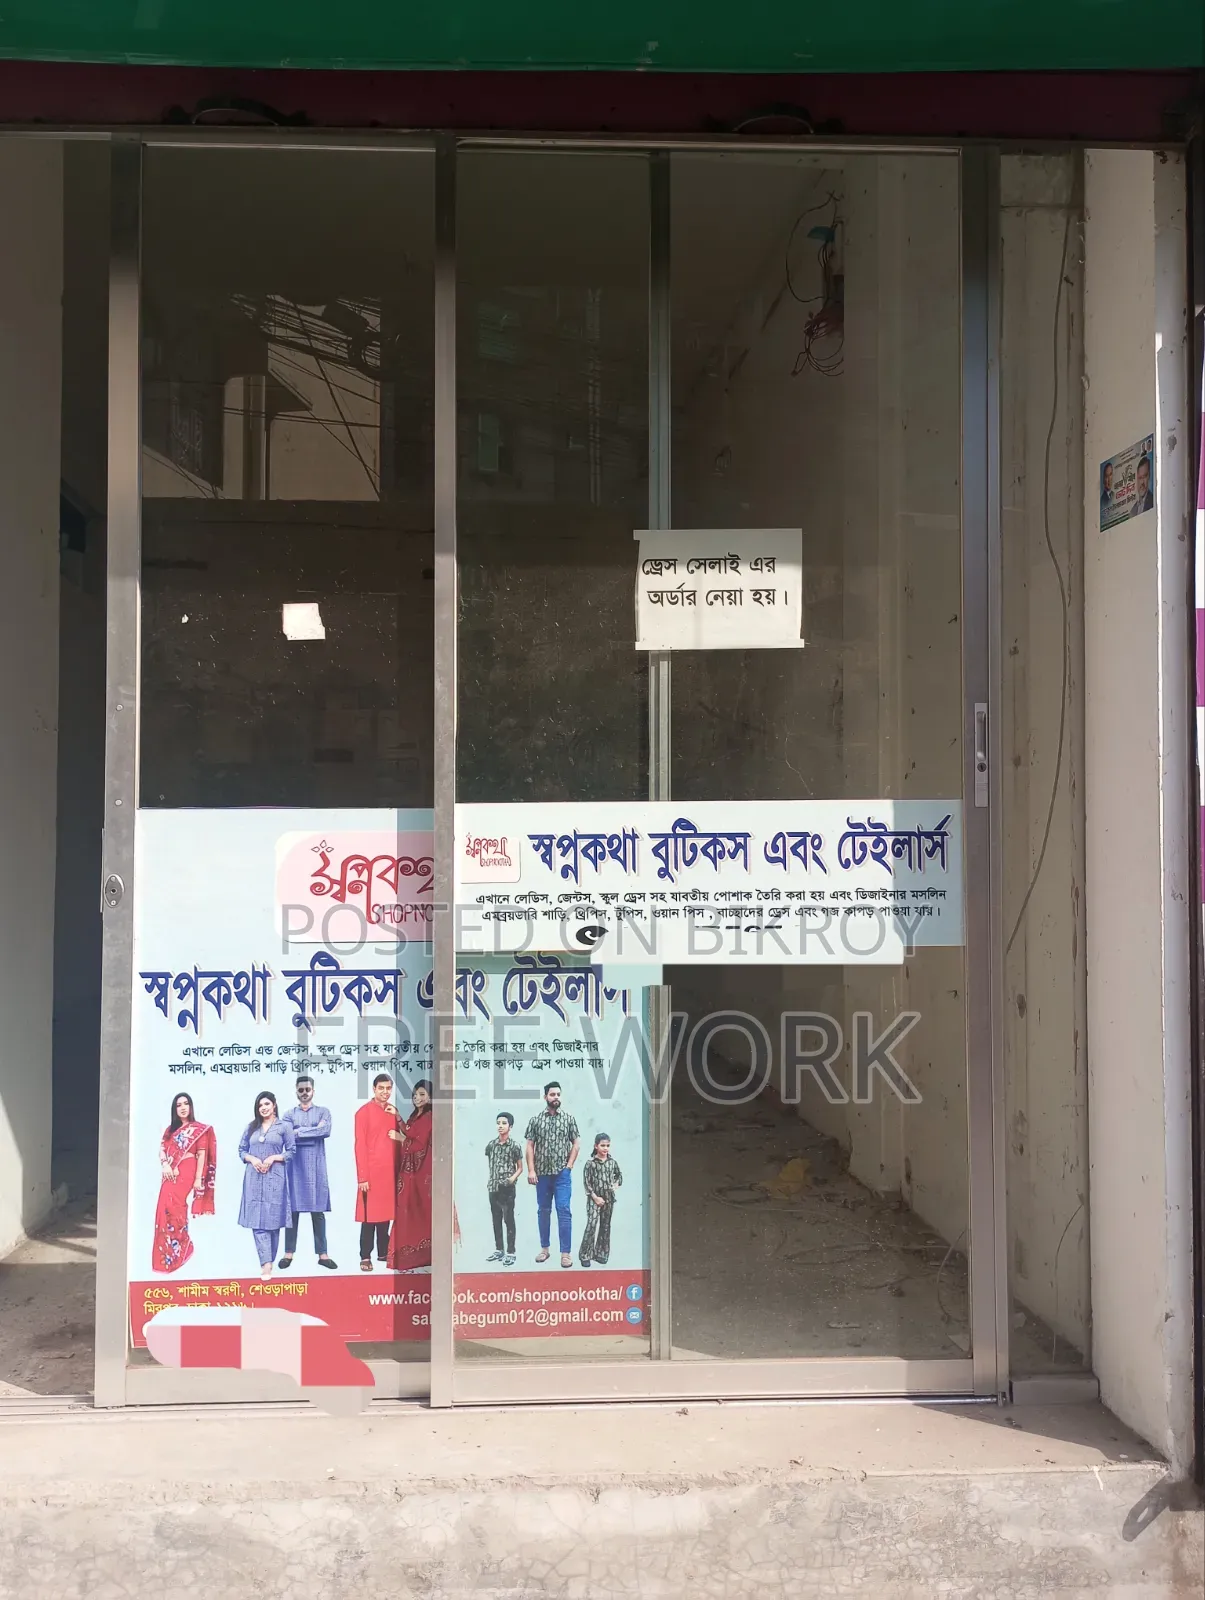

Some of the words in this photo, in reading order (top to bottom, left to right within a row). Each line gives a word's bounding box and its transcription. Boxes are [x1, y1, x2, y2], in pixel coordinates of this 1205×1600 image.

[642, 558, 678, 576] ড্রেস
[686, 552, 741, 575] সেলাই
[750, 557, 776, 574] এর
[647, 582, 697, 607] অর্ডার
[705, 587, 743, 606] নেয়া
[528, 827, 640, 885] স্বপ্নকথা
[648, 818, 751, 883] বুটিকস
[764, 831, 827, 874] এবং
[838, 815, 951, 876] টেইলার্স
[476, 893, 510, 904] এখানে
[515, 891, 552, 905] লেডিস,
[599, 892, 619, 905] স্কুল
[624, 892, 646, 904] ড্রেস
[650, 892, 667, 903] সহ
[670, 888, 709, 902] যাবতীয়
[714, 890, 753, 901] পোশাক
[755, 888, 781, 901] তৈরি
[785, 890, 805, 901] করা
[809, 890, 825, 901] হয়
[830, 890, 853, 901] এবং
[855, 887, 907, 901] ডিজাইনার
[910, 887, 947, 900] মসলিন
[652, 907, 680, 919] ওয়ান
[768, 907, 791, 919] ড্রেস
[795, 907, 819, 918] এবং
[821, 906, 840, 917] গজ
[843, 906, 875, 918] কাপড়
[879, 906, 911, 917] পাওয়া
[138, 962, 272, 1035] স্বপ্নকথা
[281, 950, 404, 1034] বুটিকস
[183, 1045, 215, 1057] এখানে
[219, 1043, 252, 1056] লেডিস
[340, 1044, 360, 1055] ড্রেস
[364, 1044, 380, 1055] সহ
[383, 1040, 420, 1054] যাবতীয়
[463, 1040, 486, 1053] তৈরি
[489, 1042, 508, 1053] করা
[511, 1042, 526, 1053] হয়
[529, 1042, 550, 1053] এবং
[552, 1038, 599, 1053] ডিজাইনার
[168, 1061, 206, 1076] মসলিন,
[264, 1060, 288, 1074] শাড়ি
[362, 1059, 386, 1071] ওয়ান
[390, 1057, 413, 1072] পিস,
[474, 1058, 491, 1070] গজ
[494, 1058, 523, 1071] কাপড়
[531, 1058, 551, 1070] ড্রেস
[555, 1057, 584, 1069] পাওয়া
[177, 1282, 210, 1298] শামীম
[249, 1281, 309, 1298] শেওড়াপাড়া
[369, 1286, 623, 1306] www.facook.com/shopnookotha/
